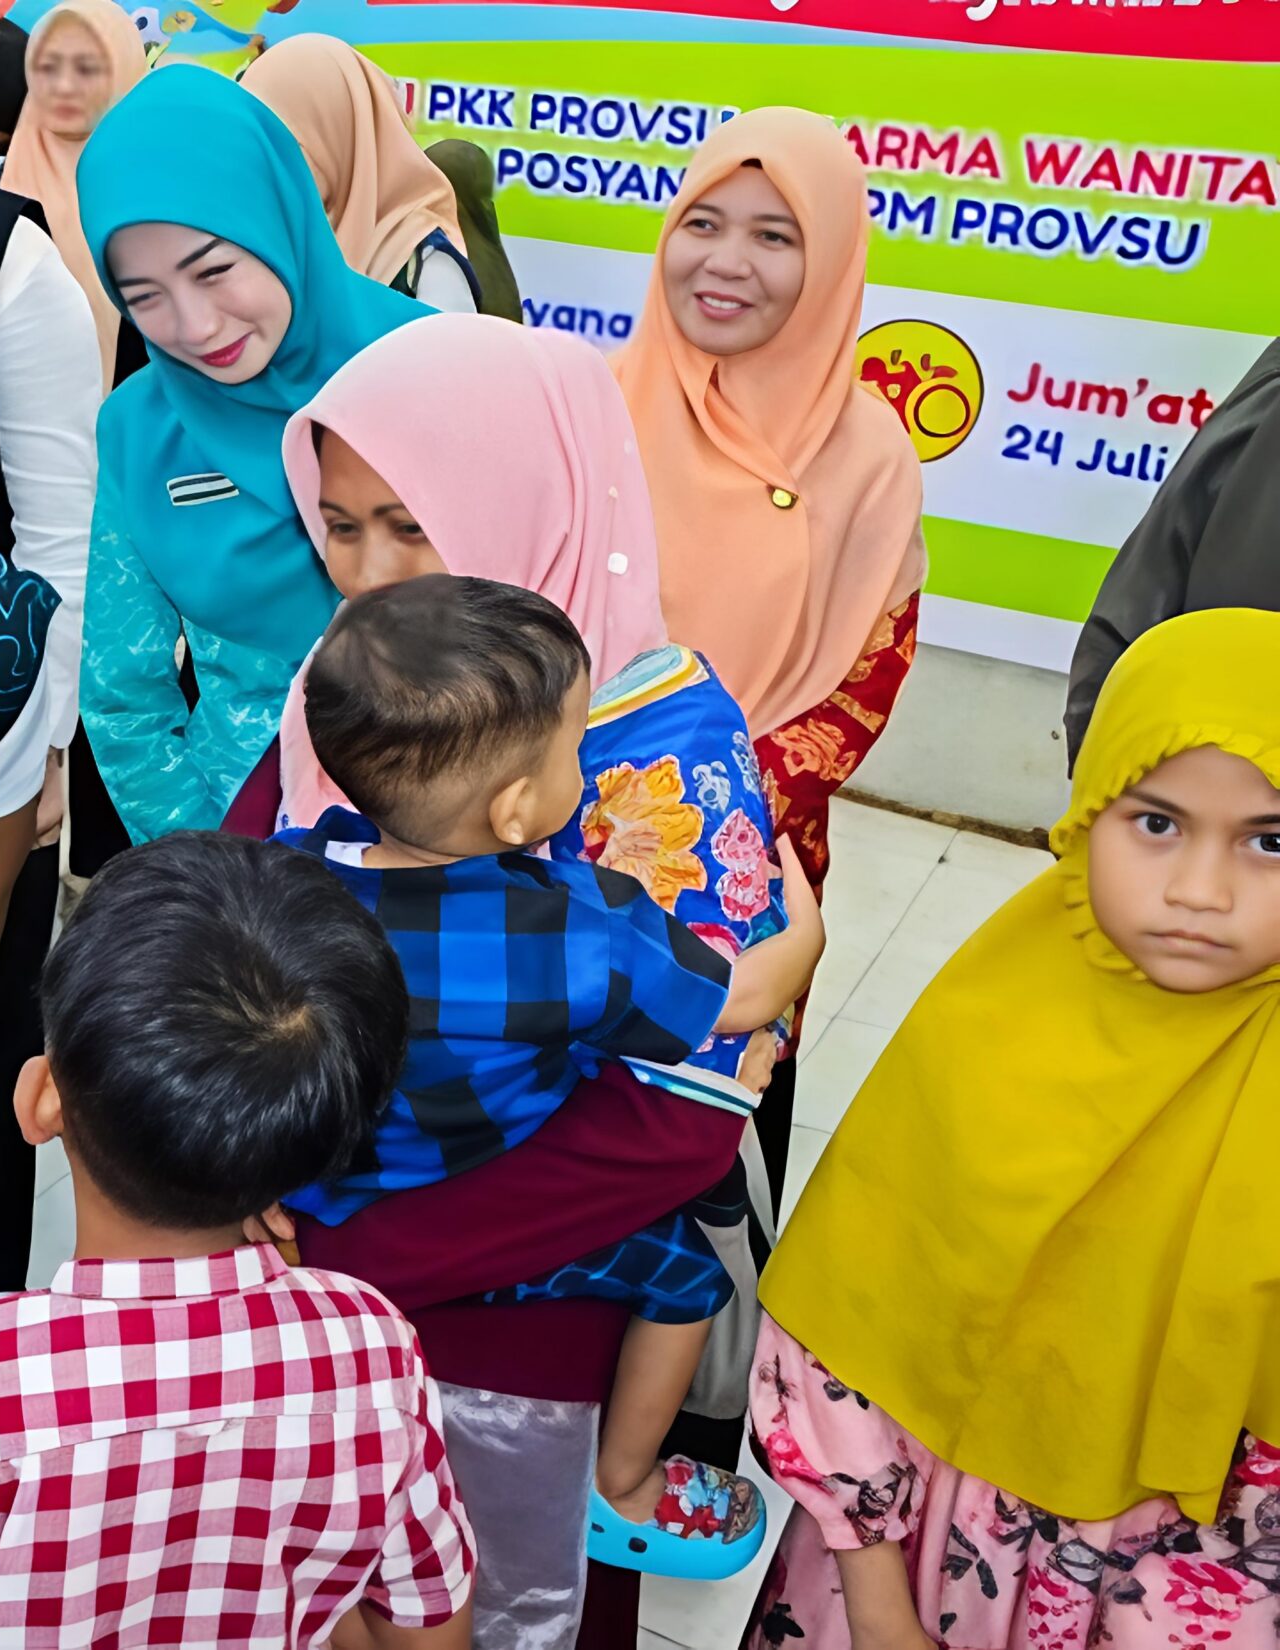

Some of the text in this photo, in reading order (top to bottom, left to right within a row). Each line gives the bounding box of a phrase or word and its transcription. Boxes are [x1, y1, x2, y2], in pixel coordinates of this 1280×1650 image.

[428, 83, 515, 128] PKK
[1024, 139, 1276, 206] WANITA
[951, 198, 1201, 265] PROVSU
[1006, 362, 1214, 430] Jum'at
[1001, 424, 1169, 483] 24 Juli
